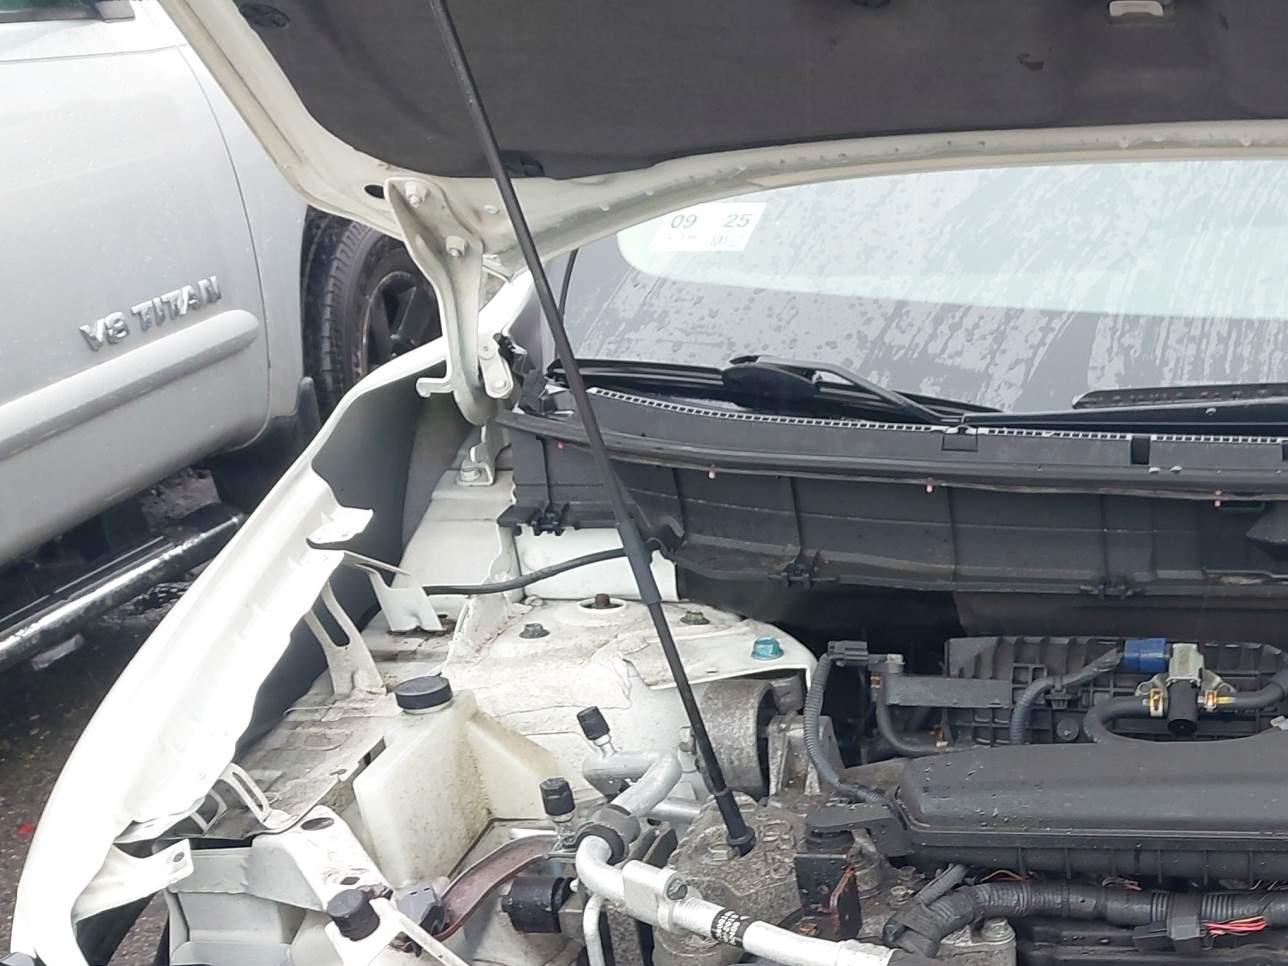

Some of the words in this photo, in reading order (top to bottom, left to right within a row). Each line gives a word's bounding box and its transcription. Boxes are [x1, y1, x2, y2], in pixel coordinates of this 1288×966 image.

[670, 213, 699, 230] 09
[722, 212, 754, 229] 25
[78, 310, 130, 353] V8
[130, 274, 223, 332] TITAN
